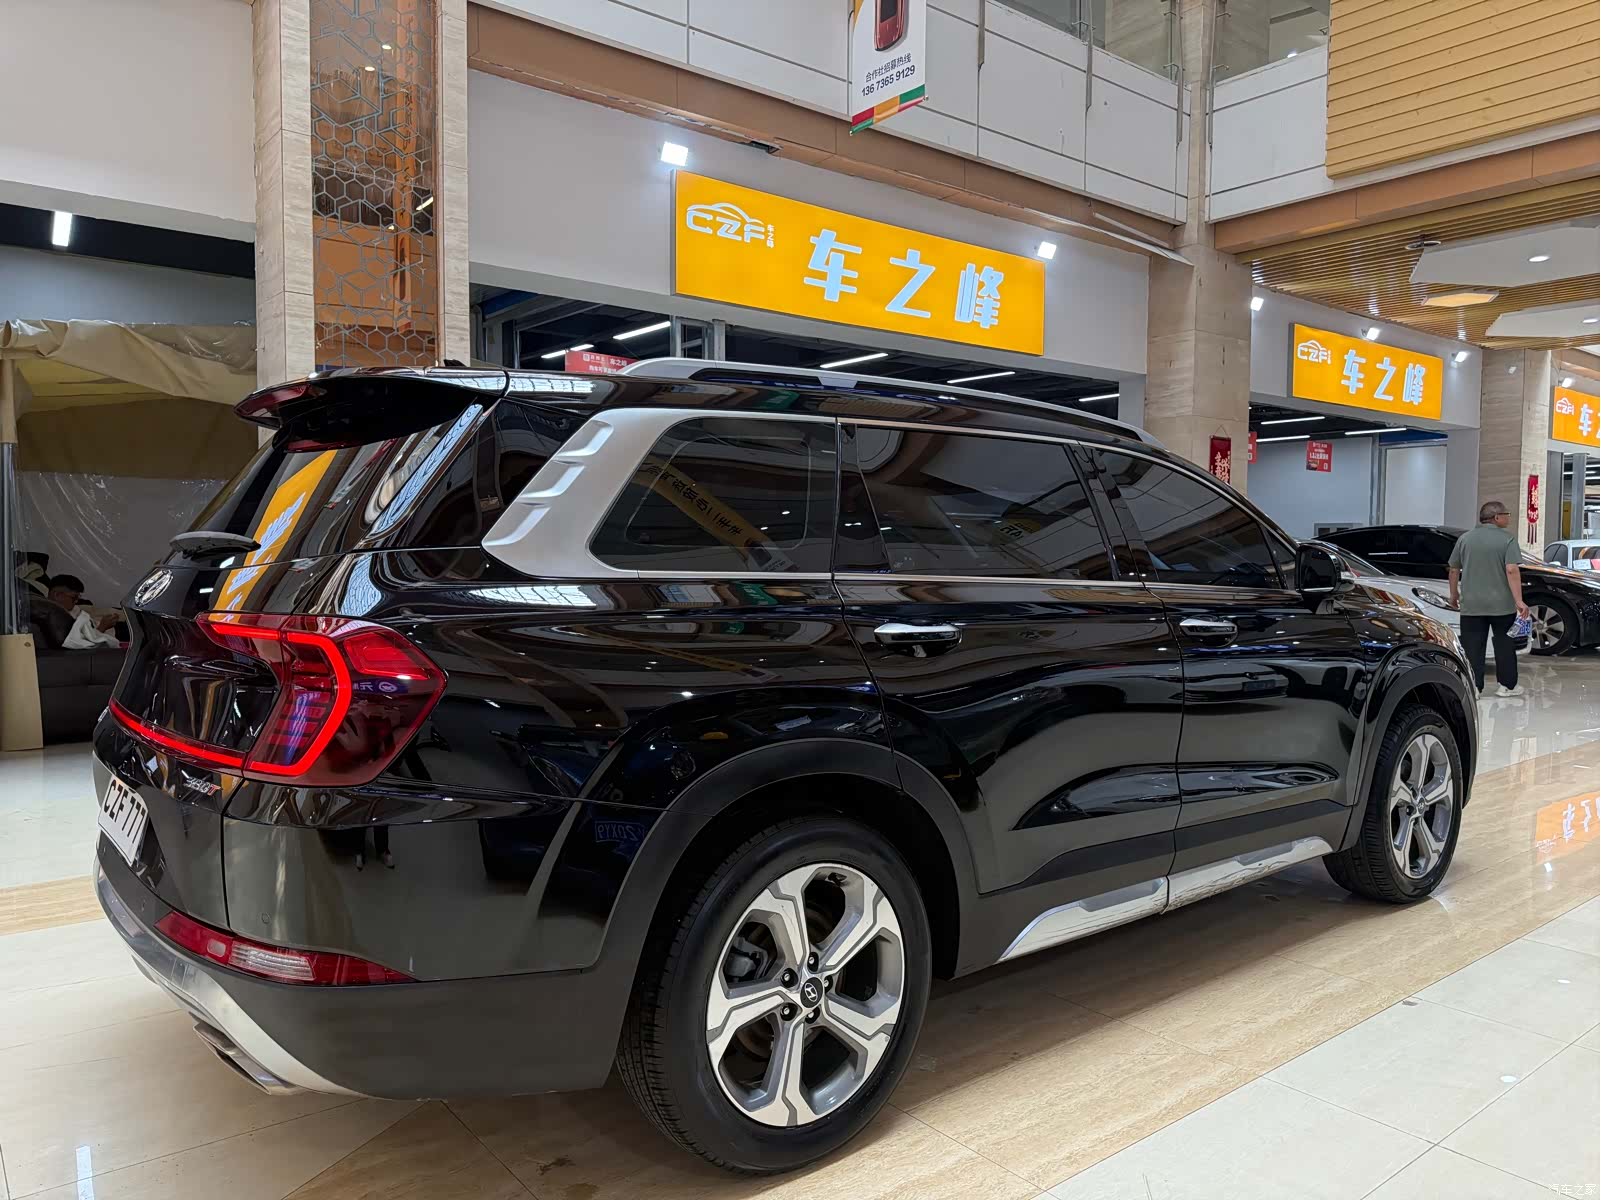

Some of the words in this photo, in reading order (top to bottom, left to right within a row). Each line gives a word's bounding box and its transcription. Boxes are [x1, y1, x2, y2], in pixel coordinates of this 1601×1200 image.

[861, 84, 875, 96] 136
[876, 74, 894, 90] 7365
[895, 65, 915, 81] 9129
[686, 209, 765, 243] CZF
[803, 228, 1004, 329] 车之峰
[1341, 349, 1426, 405] 车之峰
[1579, 403, 1600, 438] 车
[103, 779, 128, 822] CZF
[122, 796, 146, 844] 777
